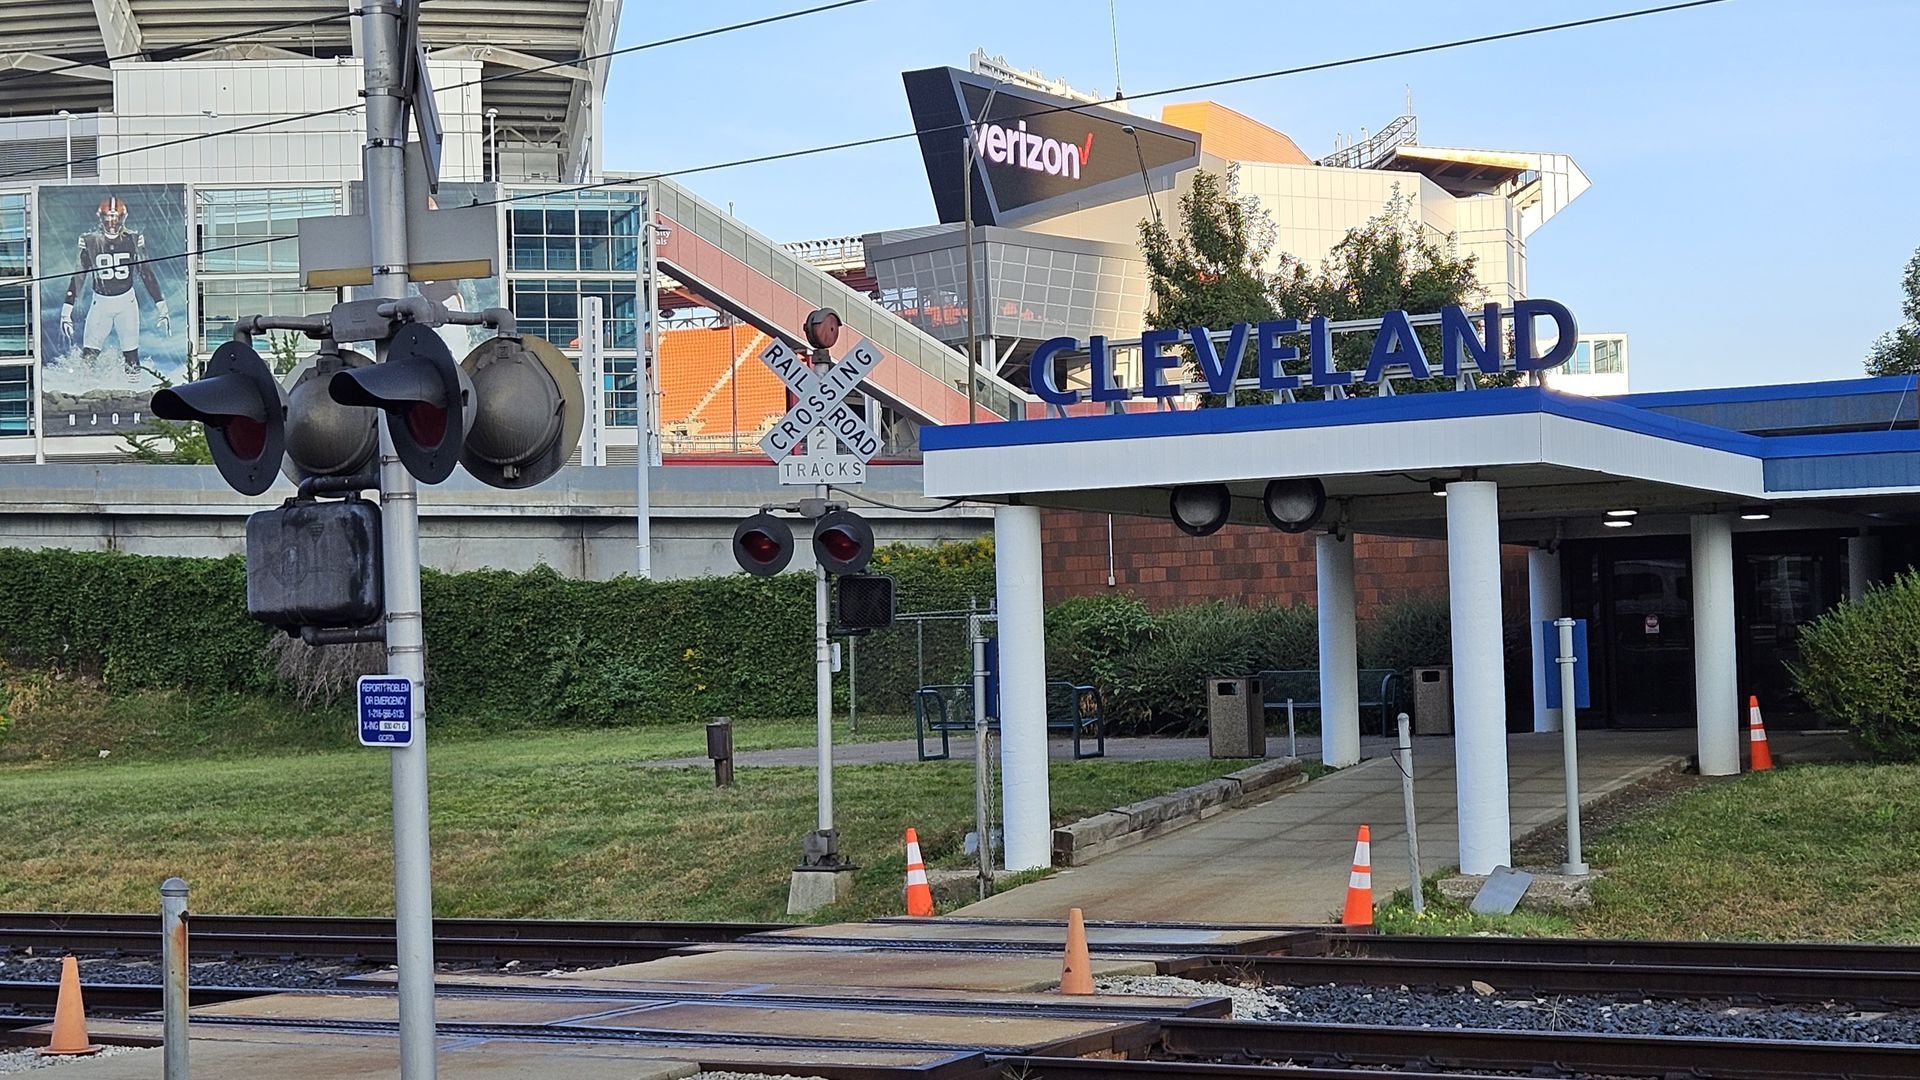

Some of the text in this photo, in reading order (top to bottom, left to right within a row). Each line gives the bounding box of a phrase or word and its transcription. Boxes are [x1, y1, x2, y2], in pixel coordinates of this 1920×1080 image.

[970, 119, 1080, 180] verizon
[95, 252, 131, 280] 85
[1029, 298, 1578, 406] CLEVELAND
[765, 344, 877, 456] RAIL ROAD
[770, 348, 873, 451] CROSSING
[69, 412, 141, 426] NJOK
[816, 429, 828, 450] 2
[783, 462, 862, 477] TRACKS
[362, 683, 409, 692] REPORT PROBLEM
[365, 696, 407, 705] OR EMERGENCY
